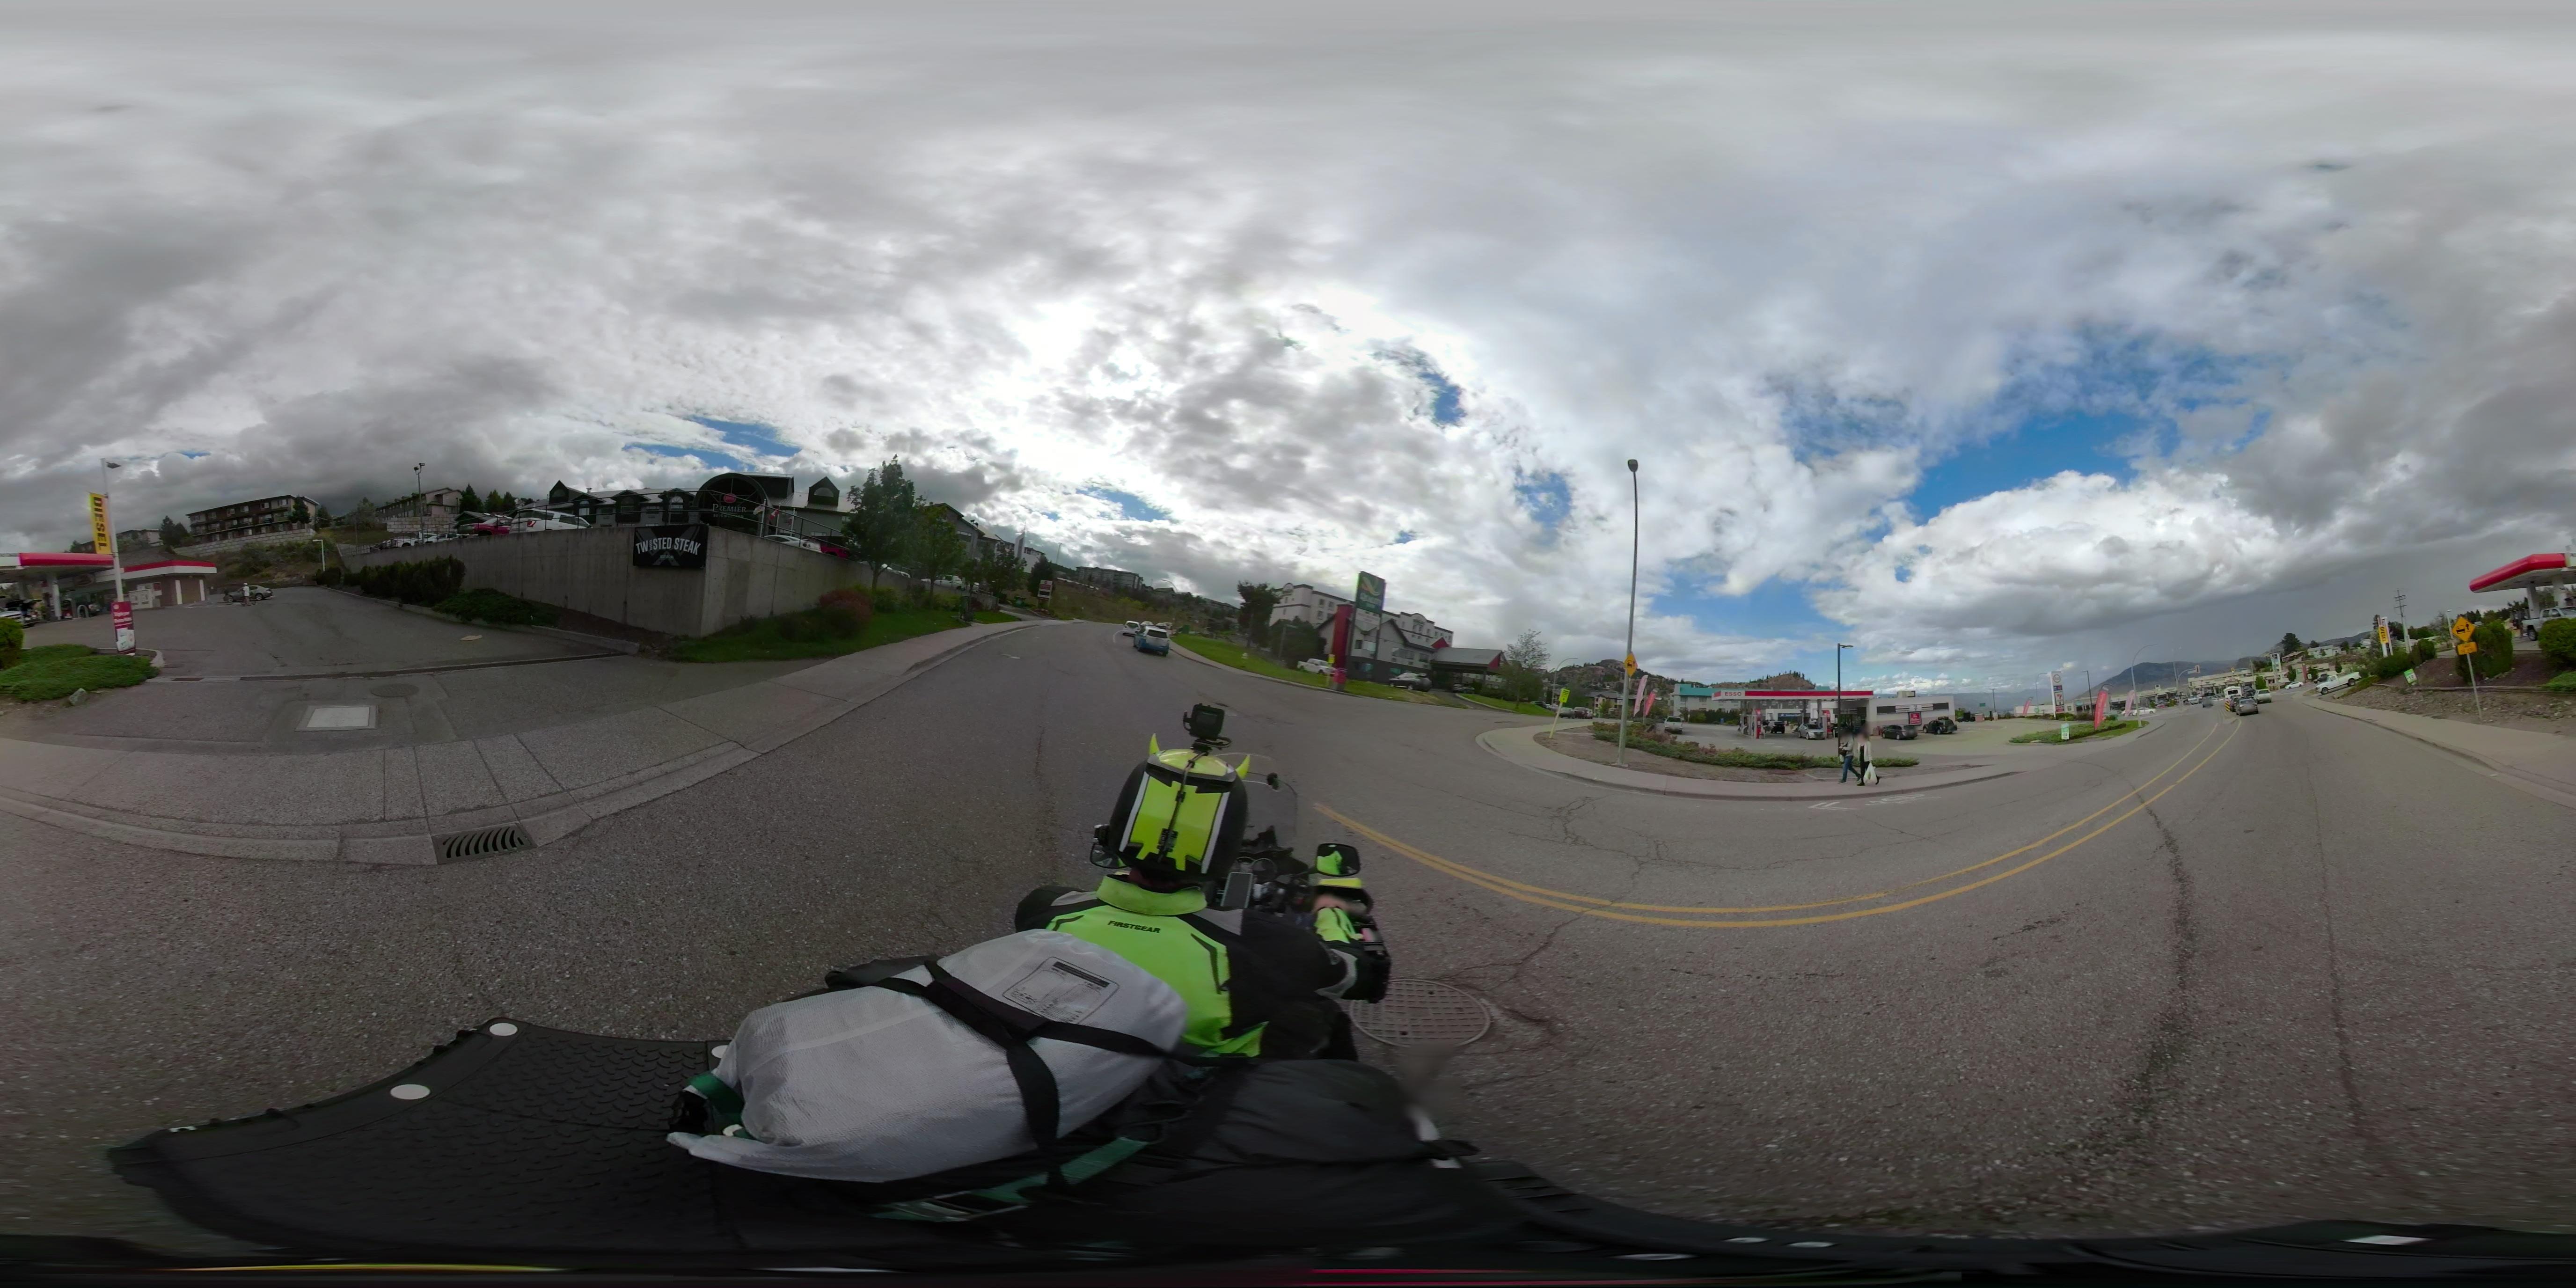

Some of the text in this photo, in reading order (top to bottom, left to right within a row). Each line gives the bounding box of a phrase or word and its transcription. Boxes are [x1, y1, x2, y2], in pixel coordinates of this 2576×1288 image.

[712, 503, 747, 512] PREMIER
[94, 497, 107, 550] DIESEL
[674, 538, 701, 555] STEAK
[1107, 920, 1161, 933] FIRSTGEAR
